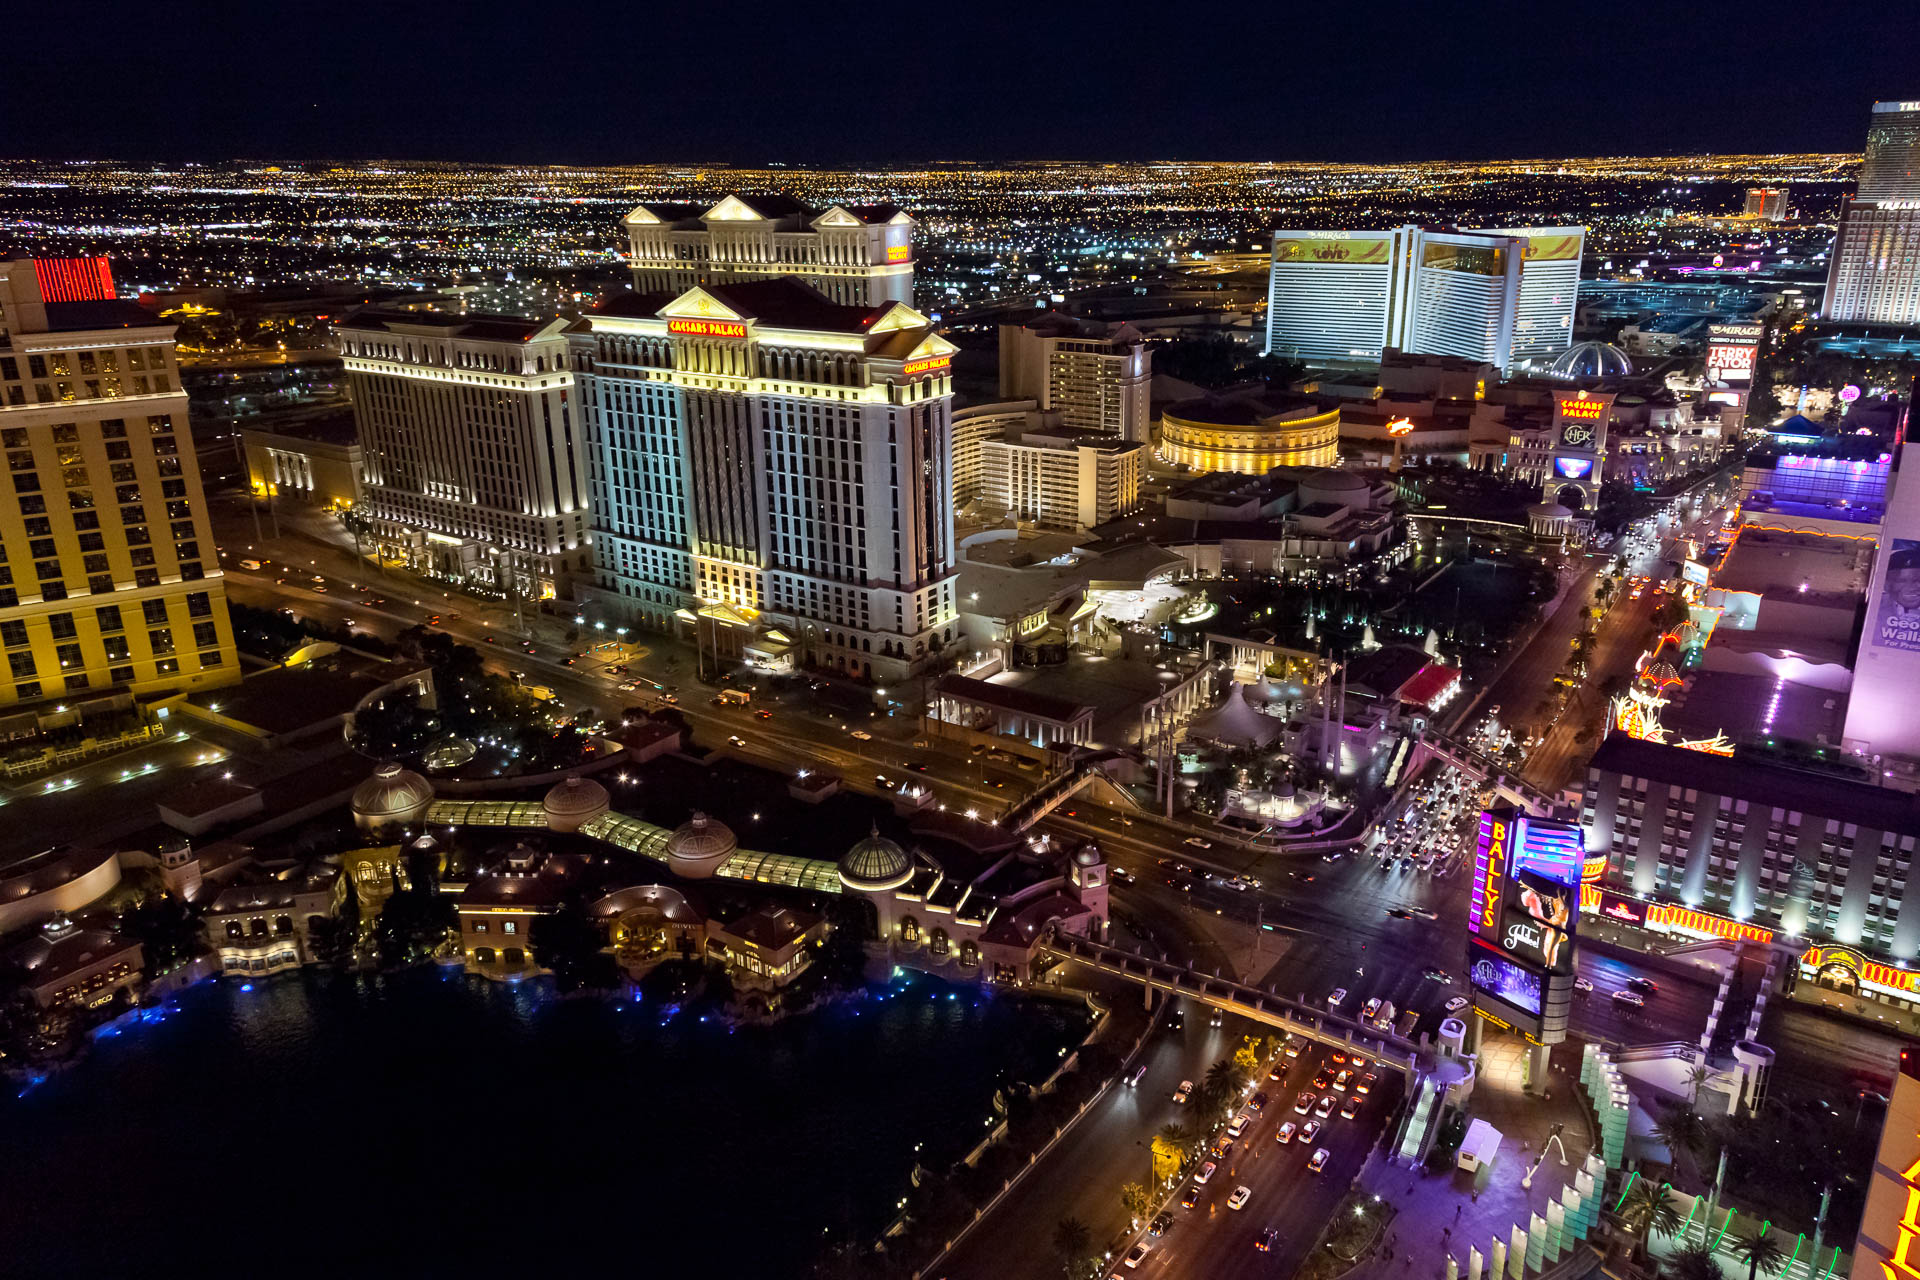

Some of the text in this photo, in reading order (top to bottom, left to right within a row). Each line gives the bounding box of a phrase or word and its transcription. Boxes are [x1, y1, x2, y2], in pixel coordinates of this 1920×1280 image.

[1317, 231, 1351, 240] MIRAGE
[669, 320, 745, 336] CAESARS PALACE
[1721, 326, 1762, 336] MIRAGE
[1709, 346, 1755, 360] TERRY
[904, 357, 950, 374] CAESARS PALACE
[1707, 357, 1752, 369] FATOR
[1561, 400, 1604, 411] CAESARS
[1562, 408, 1600, 419] PALACE
[1564, 425, 1591, 445] CHER
[1886, 616, 1920, 630] Geo
[1881, 627, 1920, 642] Wall
[89, 994, 113, 1009] CIRCO
